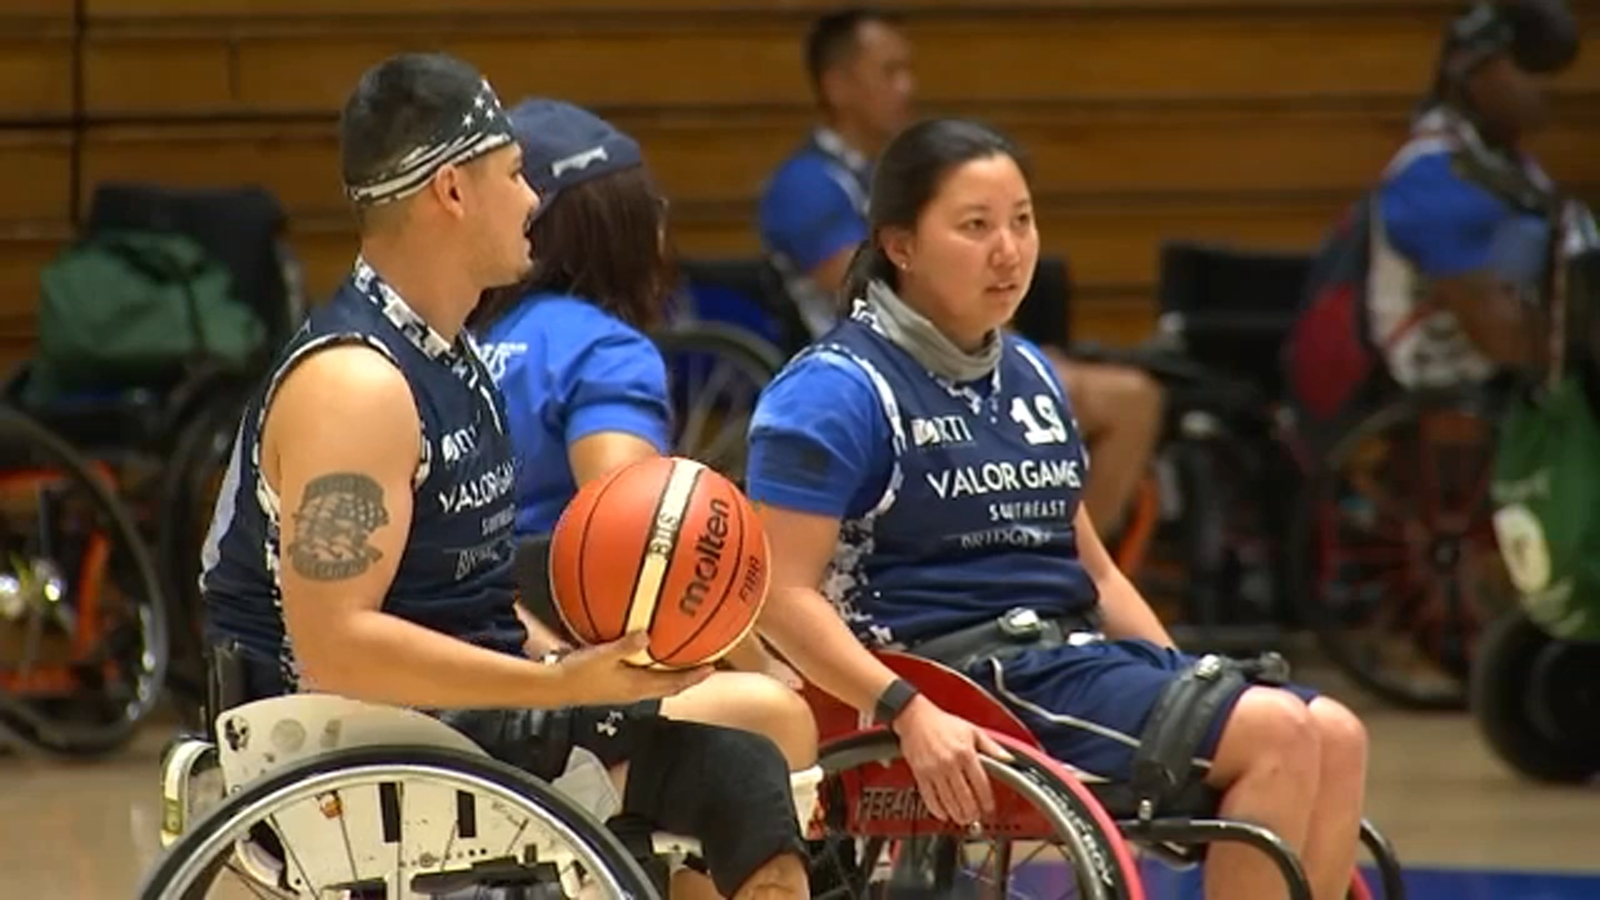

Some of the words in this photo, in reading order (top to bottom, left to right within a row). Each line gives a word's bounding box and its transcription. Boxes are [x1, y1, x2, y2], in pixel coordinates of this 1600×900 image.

[1010, 395, 1067, 444] 19
[926, 460, 1020, 499] VALOR
[679, 497, 730, 618] molten
